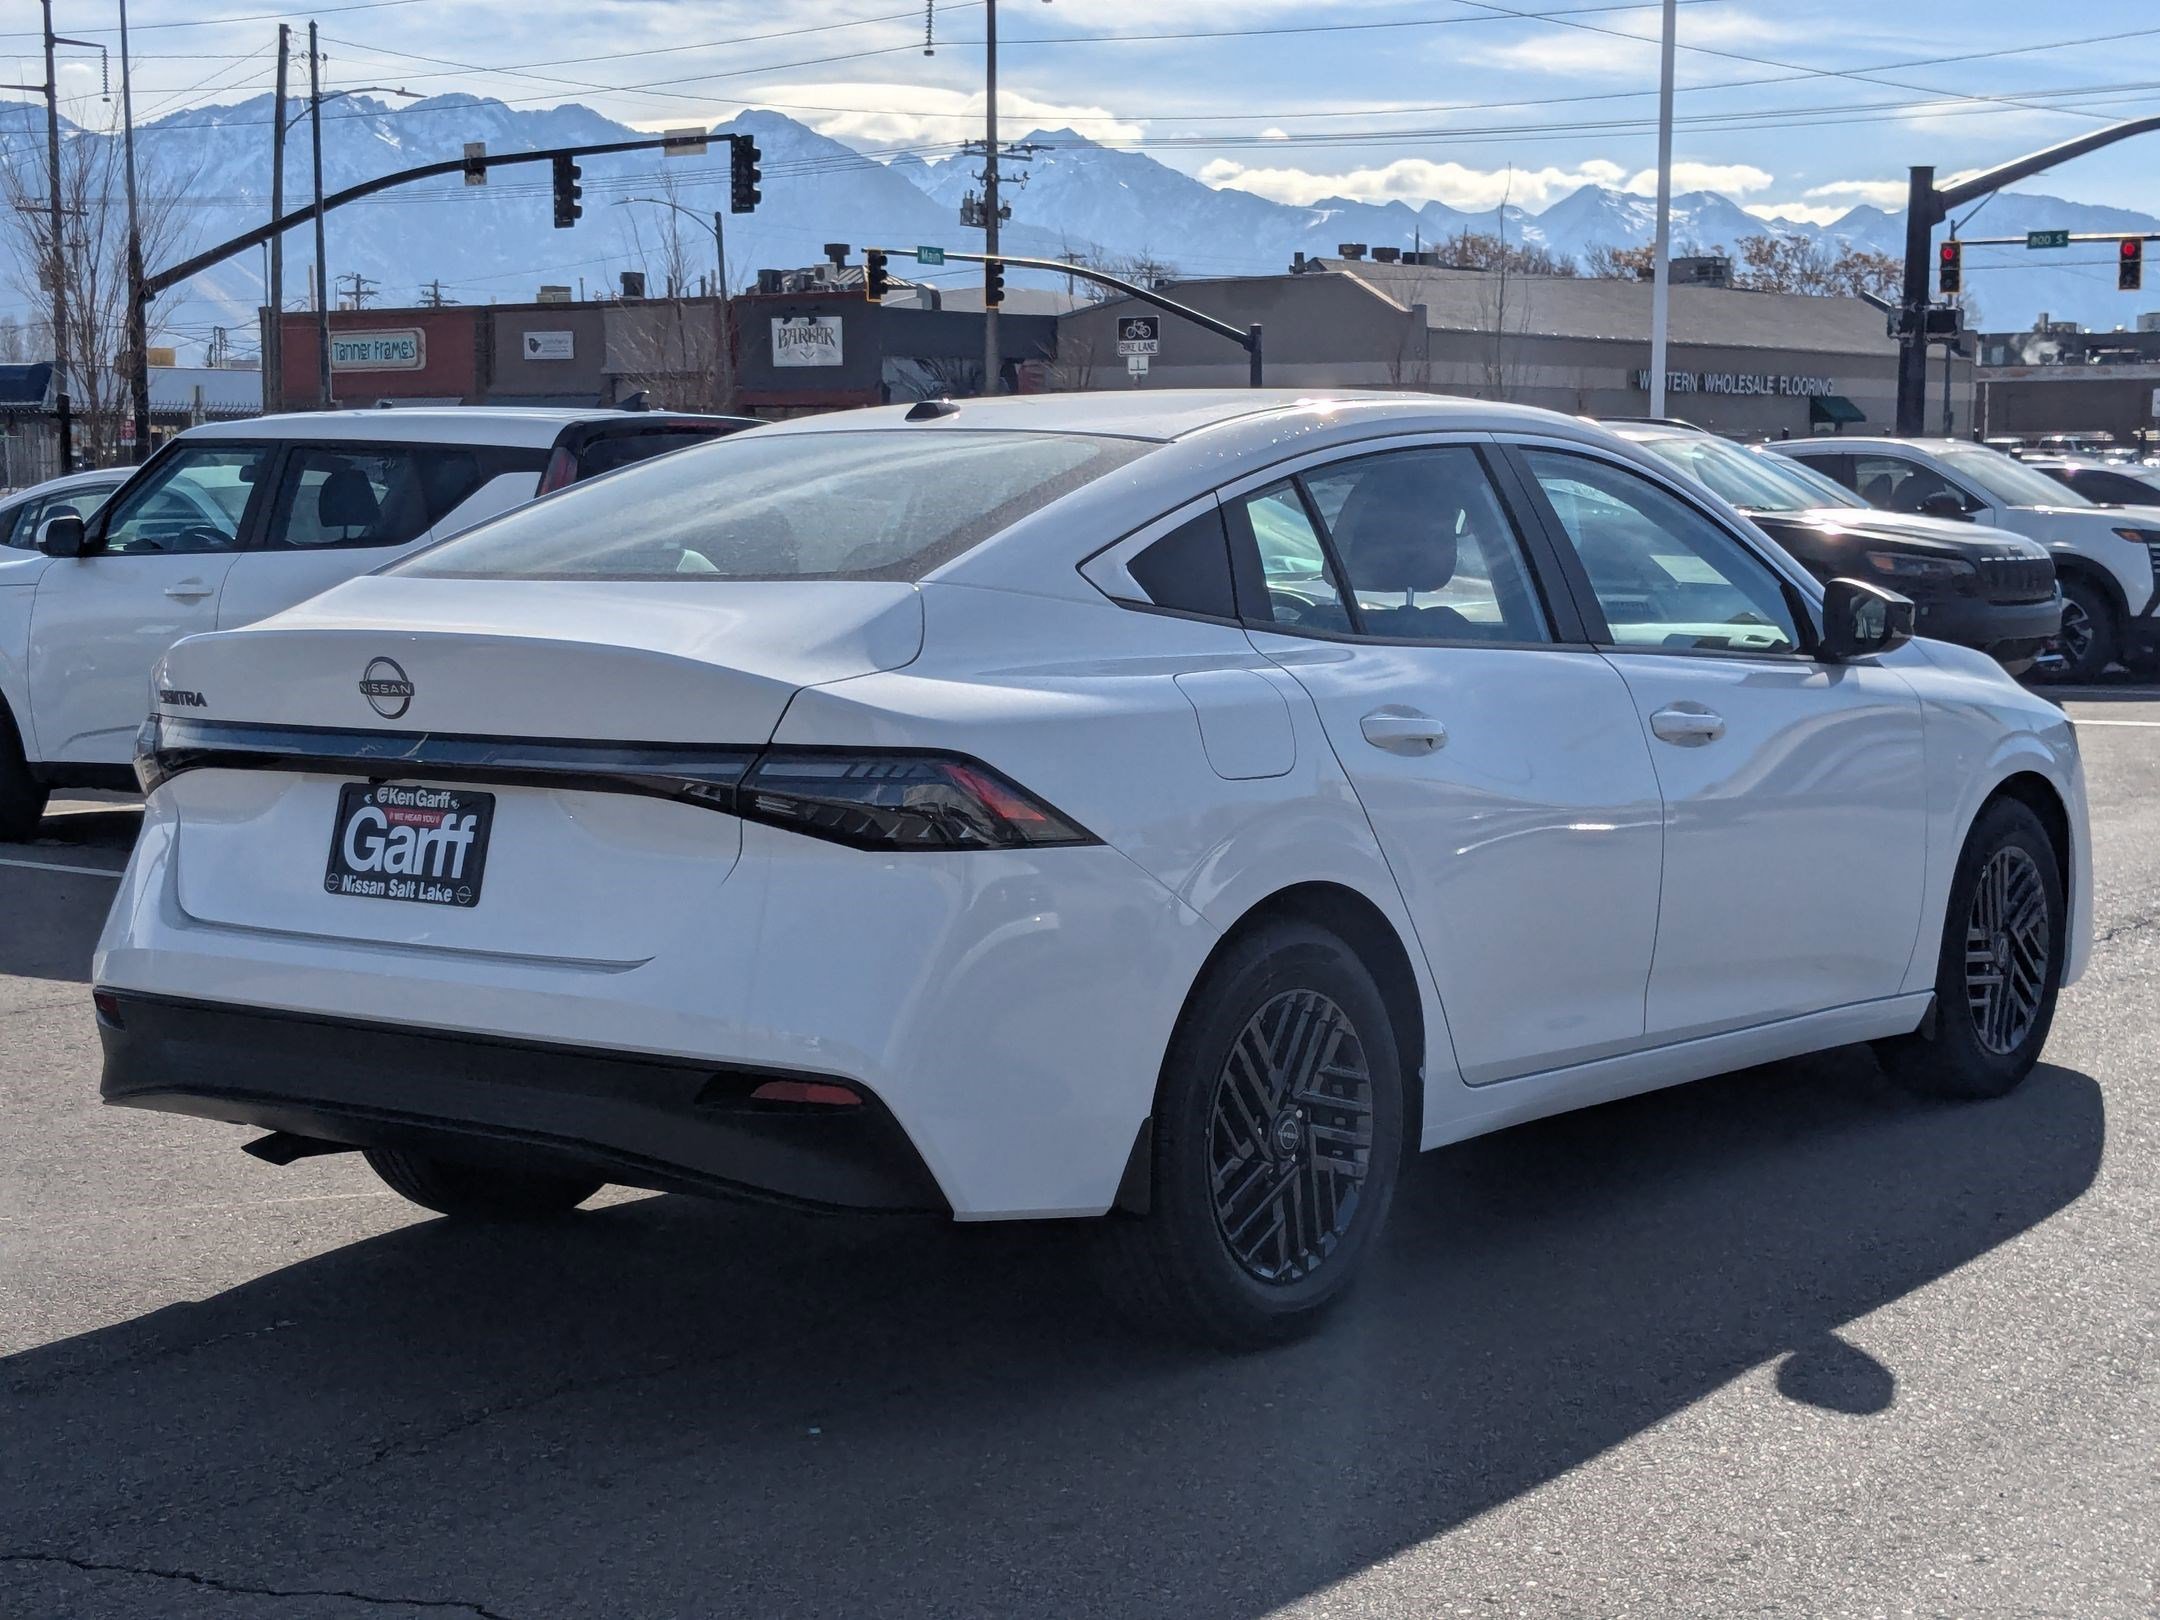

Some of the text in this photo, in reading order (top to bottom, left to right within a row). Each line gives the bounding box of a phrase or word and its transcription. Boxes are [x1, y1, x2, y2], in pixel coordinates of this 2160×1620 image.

[2056, 234, 2064, 244] S
[777, 326, 836, 350] BARBER
[333, 342, 371, 360] Tanner
[1639, 369, 1833, 396] WTERN WHOLESALE FLOORING
[359, 682, 411, 695] NISSAN
[388, 787, 451, 809] Ken Garff
[405, 813, 422, 822] HEAR
[423, 814, 437, 824] YOU
[344, 806, 477, 879] Garff
[341, 874, 453, 903] Nissan Salt Lake
